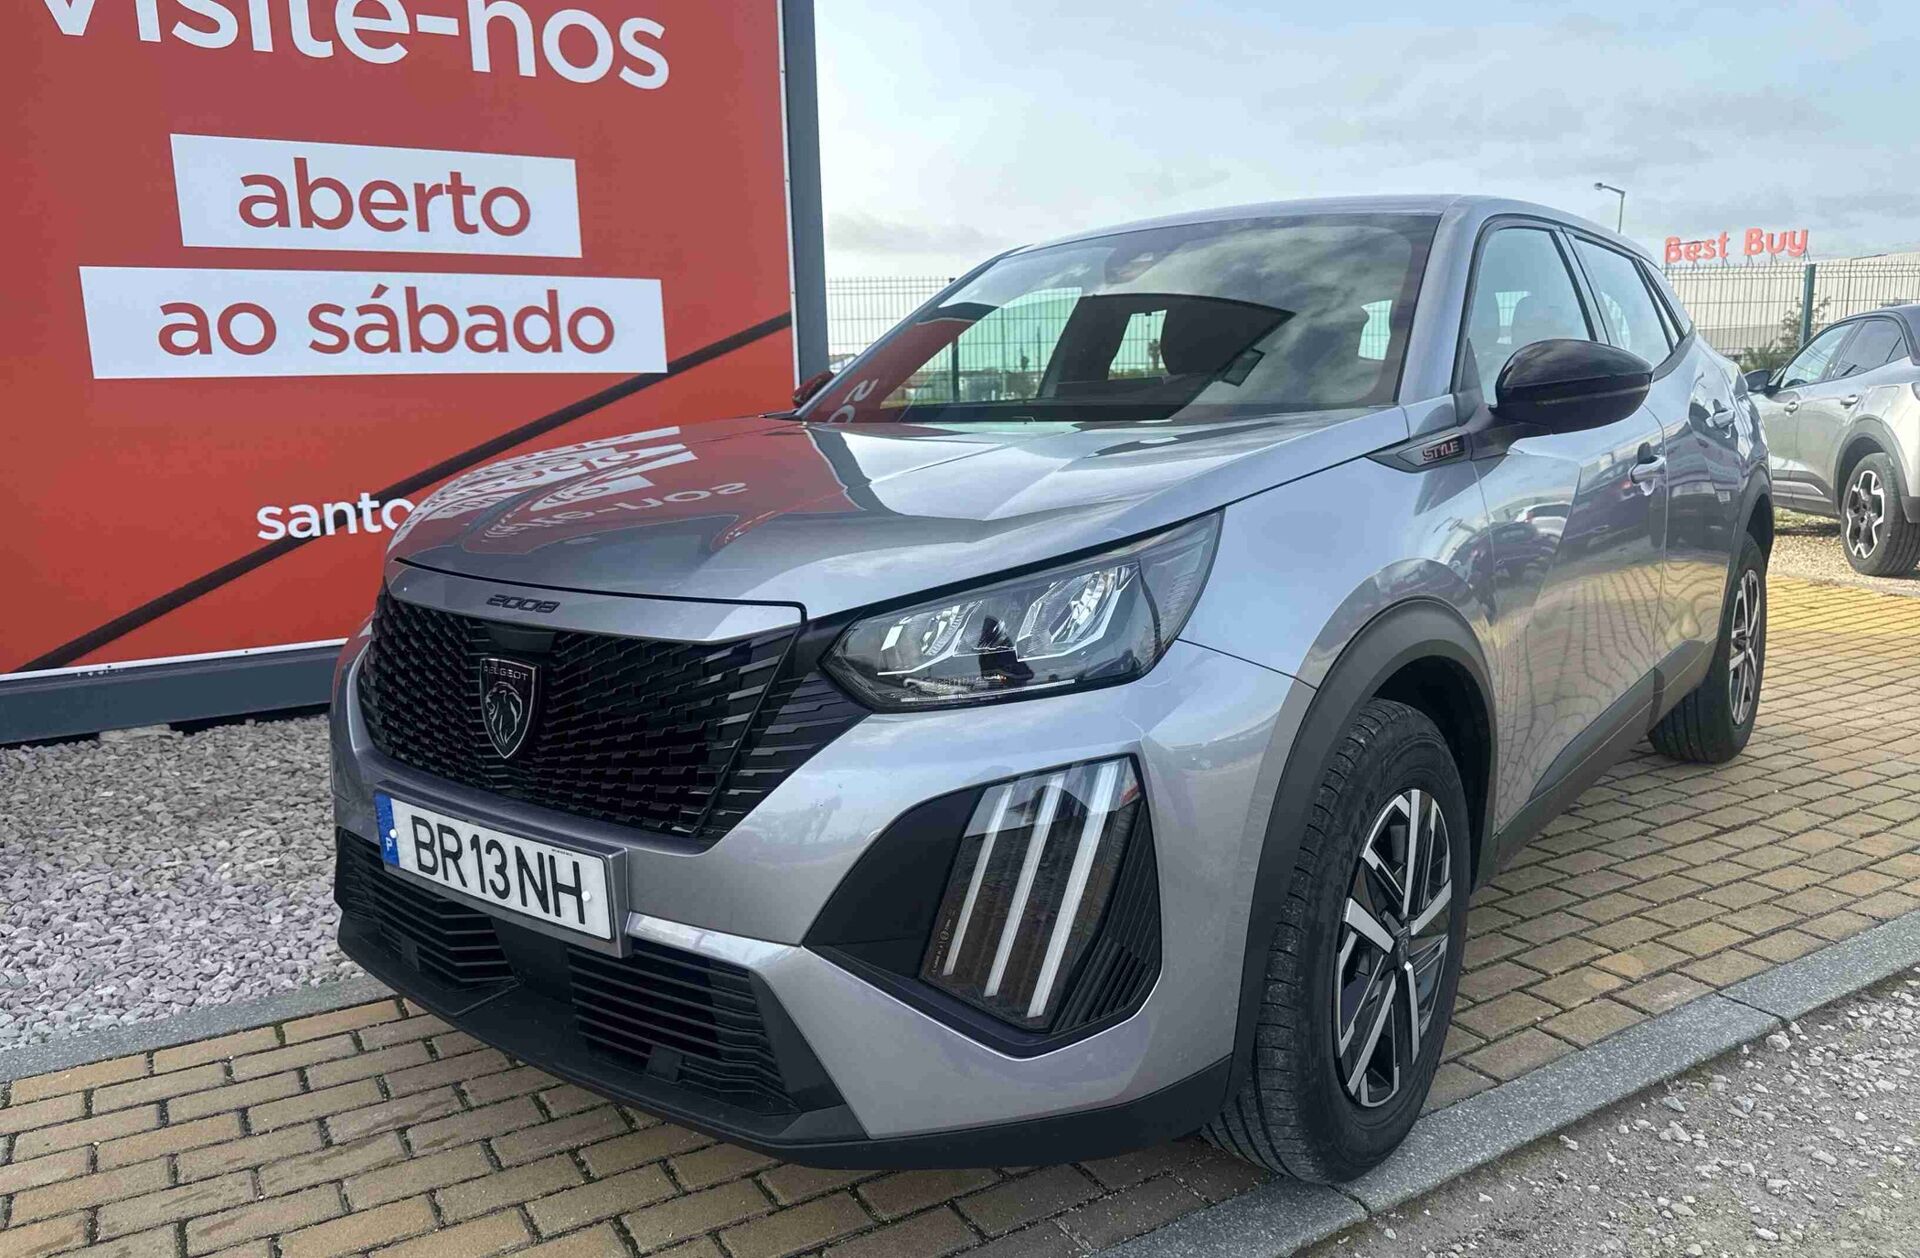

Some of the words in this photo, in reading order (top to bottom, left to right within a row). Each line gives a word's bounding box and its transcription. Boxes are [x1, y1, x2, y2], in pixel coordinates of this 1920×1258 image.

[237, 156, 532, 237] aberto
[1664, 231, 1731, 264] Best
[1743, 227, 1809, 258] Buy
[157, 300, 278, 355] ao
[308, 283, 616, 355] sábado
[1422, 440, 1459, 460] STYLE
[486, 594, 560, 614] 2008
[484, 665, 529, 681] PEUGEOT
[385, 836, 393, 852] P
[410, 814, 586, 926] BR13NH
